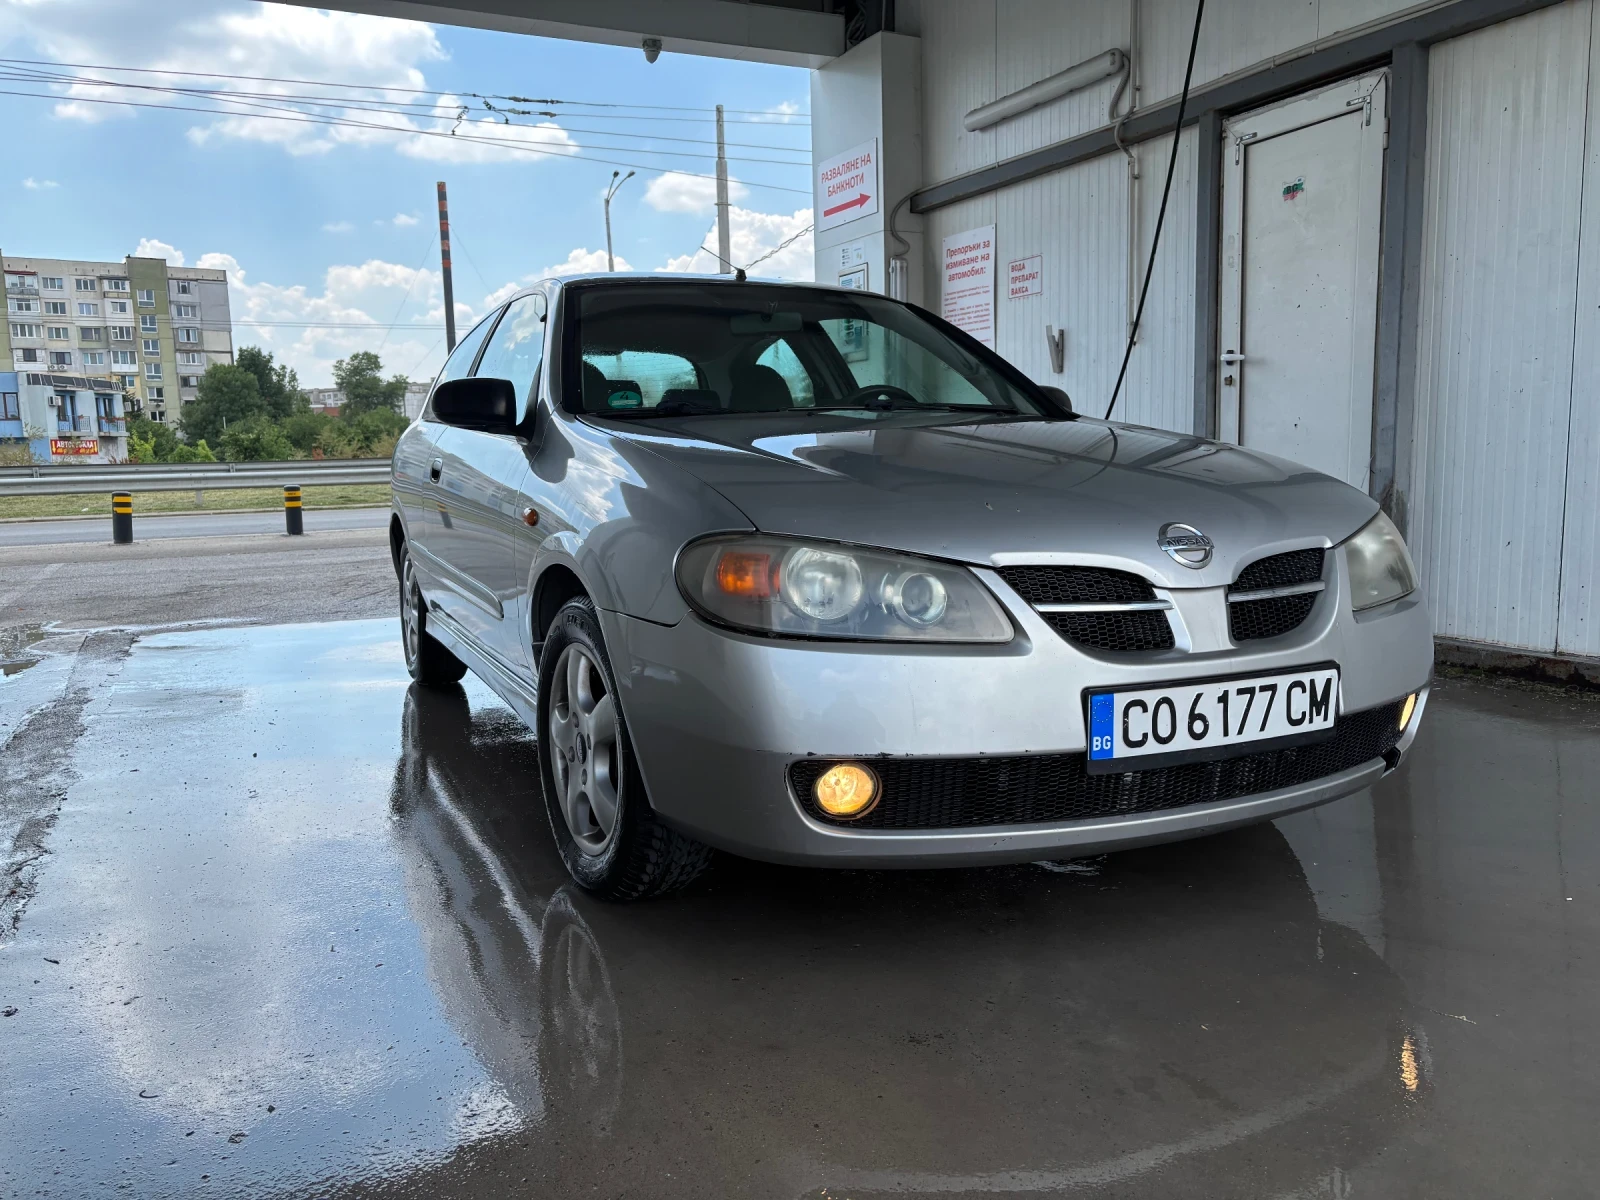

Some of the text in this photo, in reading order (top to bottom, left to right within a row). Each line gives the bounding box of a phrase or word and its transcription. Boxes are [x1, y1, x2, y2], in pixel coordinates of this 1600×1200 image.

[821, 153, 872, 184] РАЗВАЛЯНЕ НА
[828, 172, 864, 197] БАНКНОТИ
[946, 240, 990, 259] Препоръки за
[946, 253, 990, 270] измиване на
[1011, 262, 1026, 272] ВОДА
[948, 266, 986, 281] автомобил:
[1011, 271, 1039, 285] ПРЕПАРАТ
[1011, 286, 1029, 295] ВАКСА
[1166, 536, 1210, 547] NISSAN
[1122, 677, 1333, 749] CO 6177 CM
[1092, 735, 1112, 751] BG
